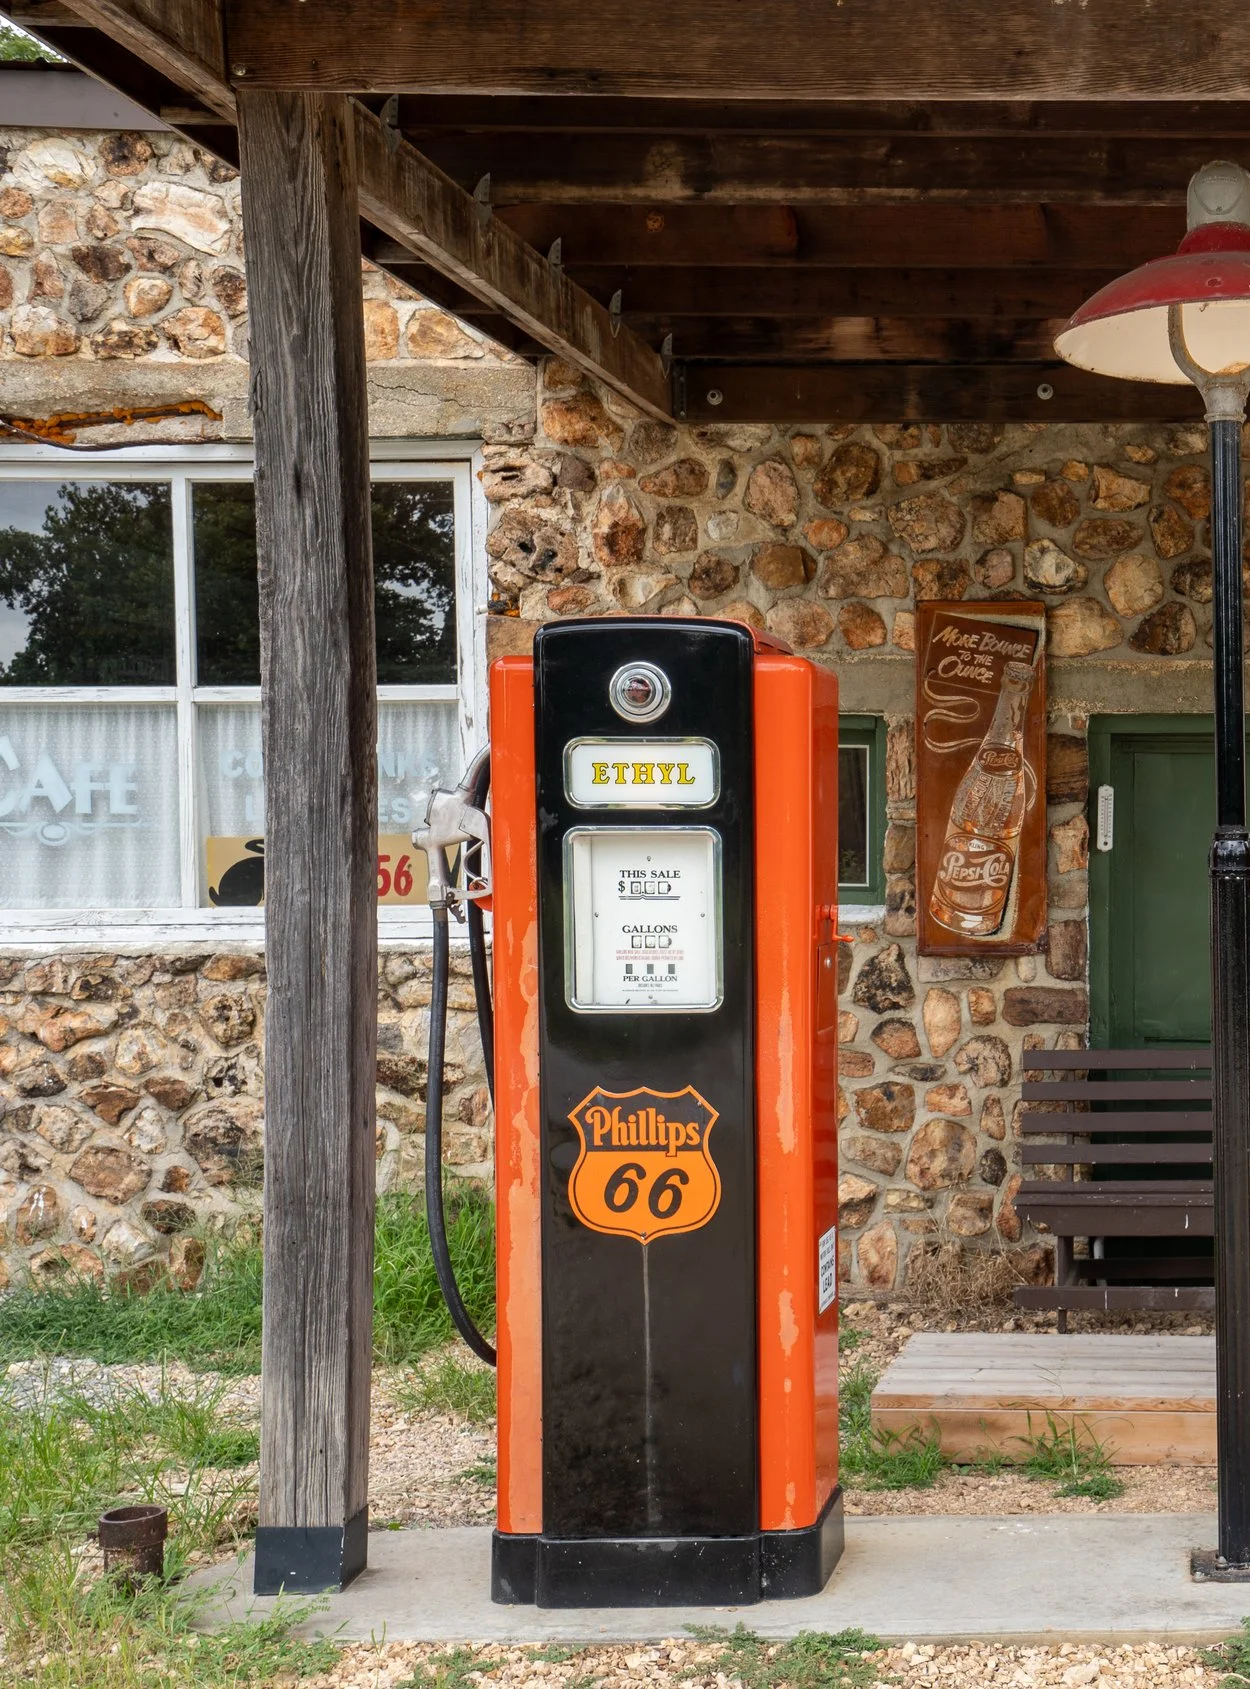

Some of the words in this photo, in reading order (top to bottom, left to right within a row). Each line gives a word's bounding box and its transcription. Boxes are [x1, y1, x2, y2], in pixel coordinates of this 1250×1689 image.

[932, 625, 980, 648] MORE
[979, 631, 1033, 658] BOUNCE
[958, 650, 972, 661] TO
[974, 654, 994, 666] THE
[592, 762, 696, 785] ETHYL
[619, 869, 647, 879] THIS
[650, 869, 681, 879] SALE
[618, 880, 625, 893] $
[622, 925, 678, 933] GALLONS
[584, 1105, 701, 1157] Phillips
[604, 1162, 690, 1219] 66
[822, 1272, 833, 1294] LEAD
